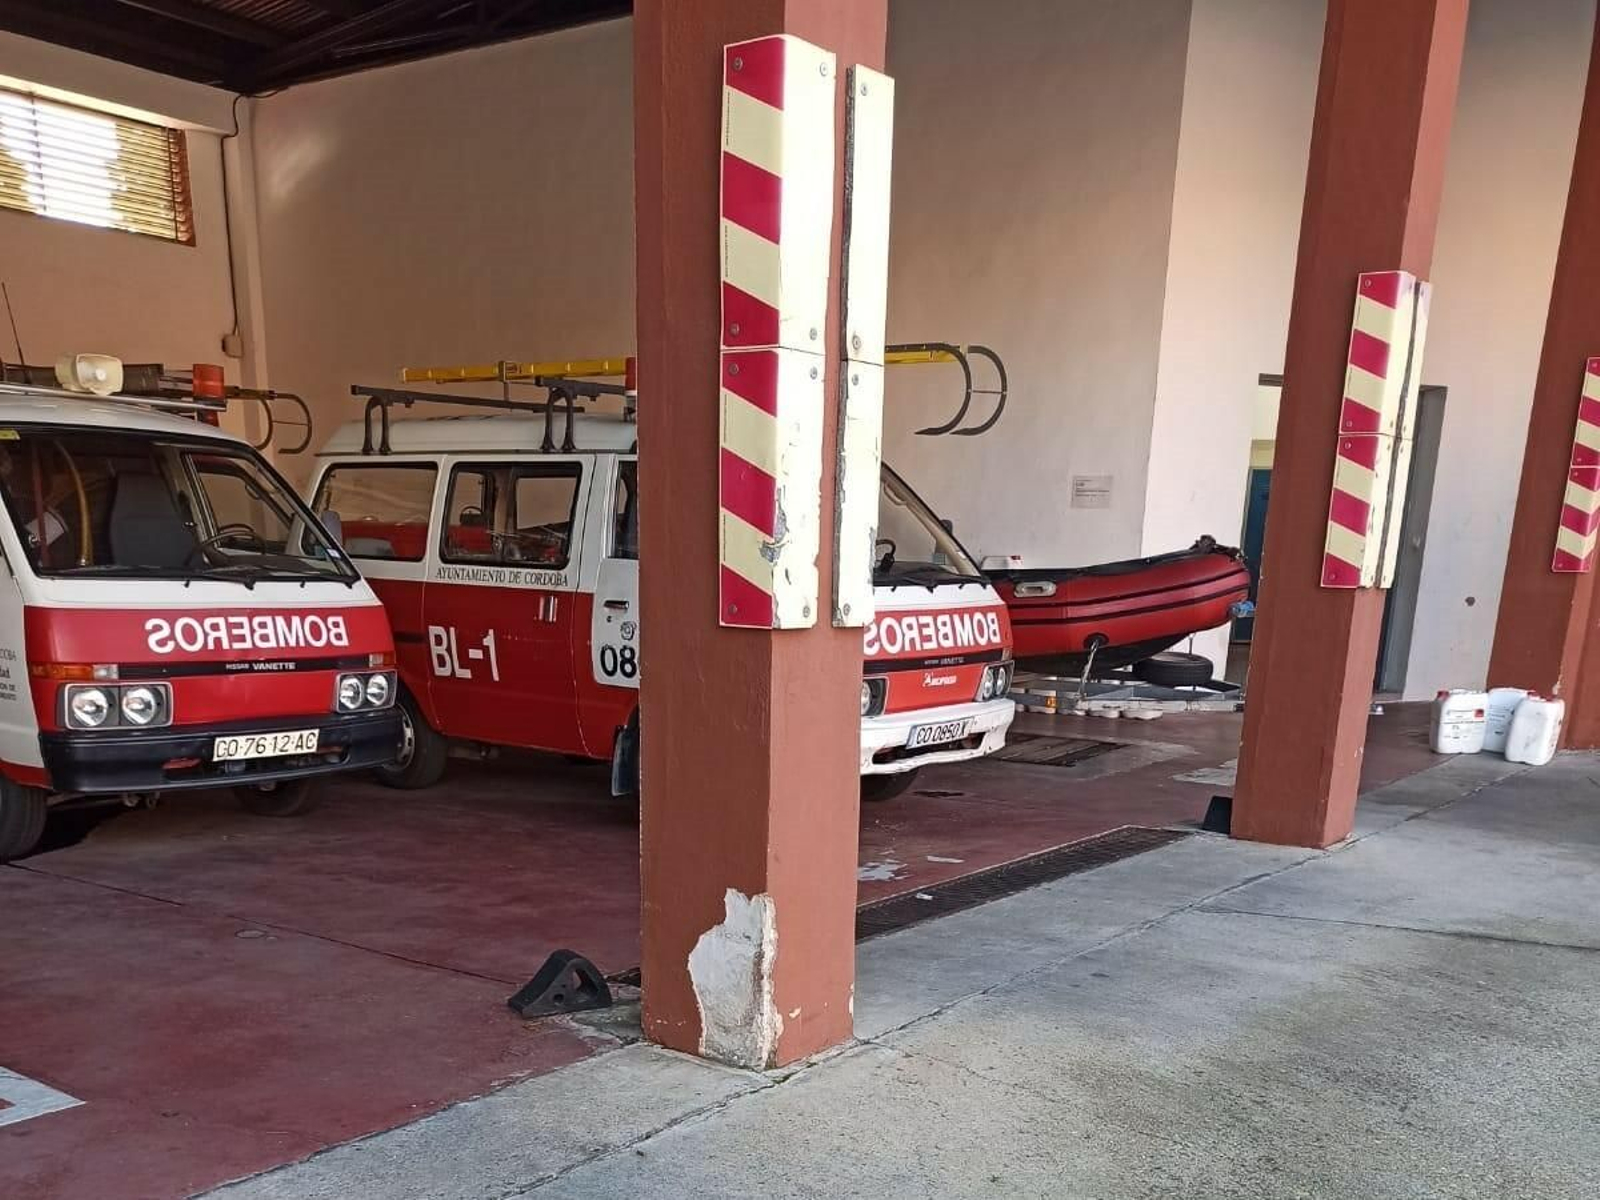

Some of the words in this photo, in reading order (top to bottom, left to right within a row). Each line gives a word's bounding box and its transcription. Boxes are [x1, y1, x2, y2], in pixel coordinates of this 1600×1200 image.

[436, 567, 505, 583] AYUNTAMIENTO
[507, 571, 521, 584] DE
[523, 572, 568, 587] CORDOBA
[428, 625, 500, 682] BL-1
[252, 661, 296, 670] VANETTE
